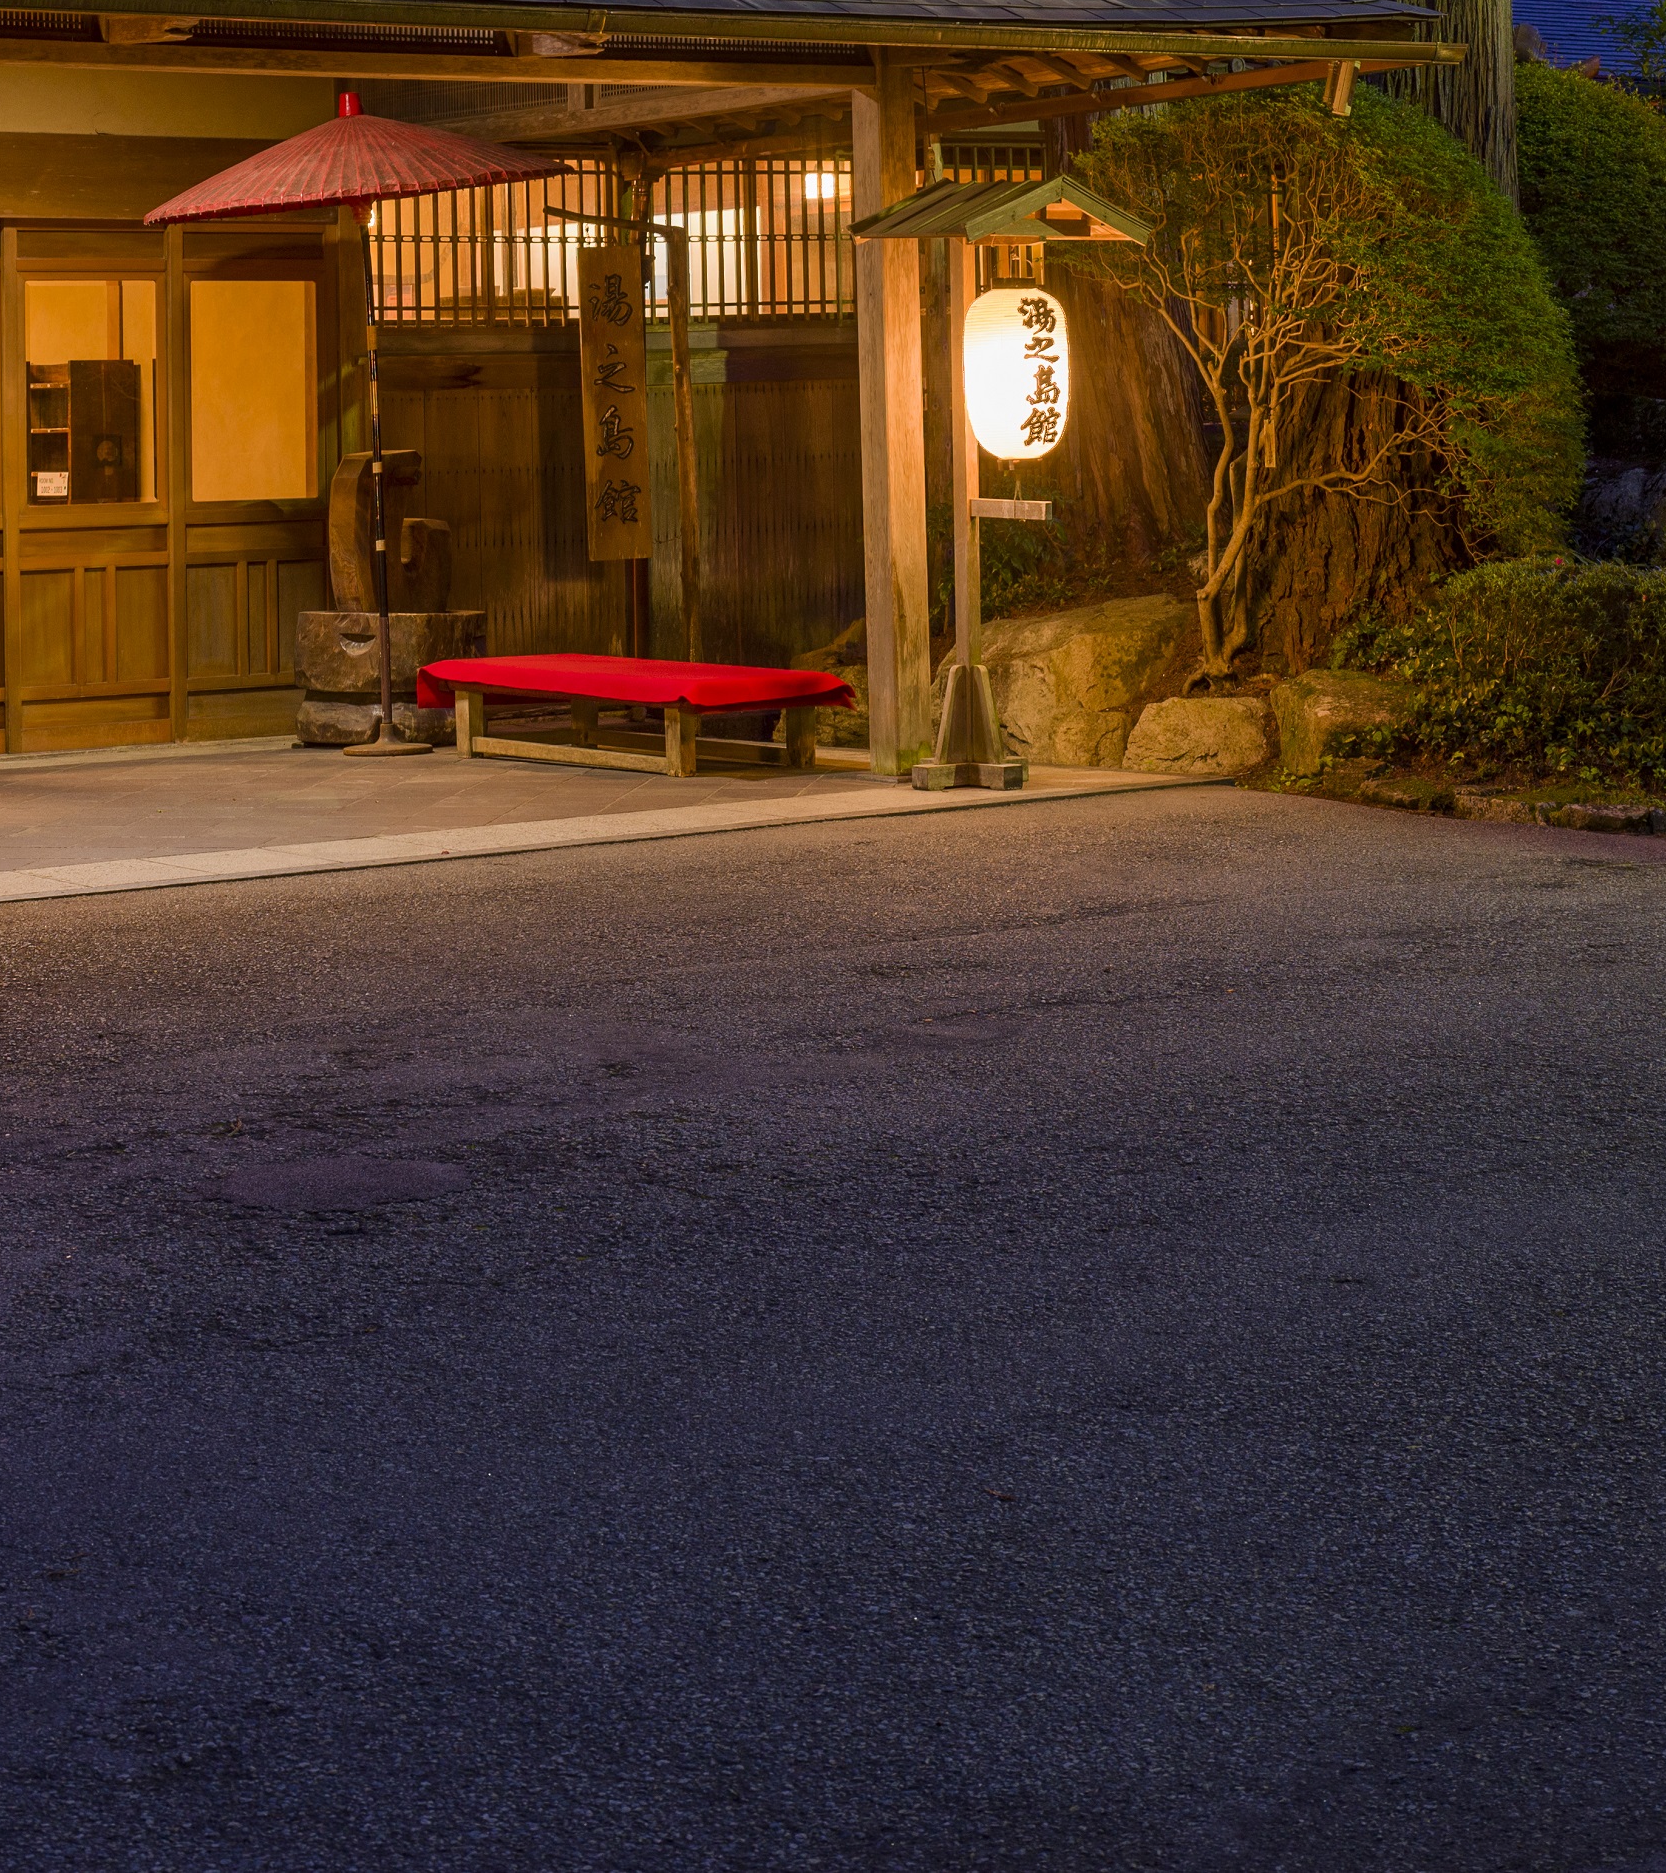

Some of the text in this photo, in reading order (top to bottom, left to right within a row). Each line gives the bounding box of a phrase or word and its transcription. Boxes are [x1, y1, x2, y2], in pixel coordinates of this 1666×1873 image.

[588, 273, 642, 524] 湯之島館
[1017, 296, 1062, 447] 湯之島館
